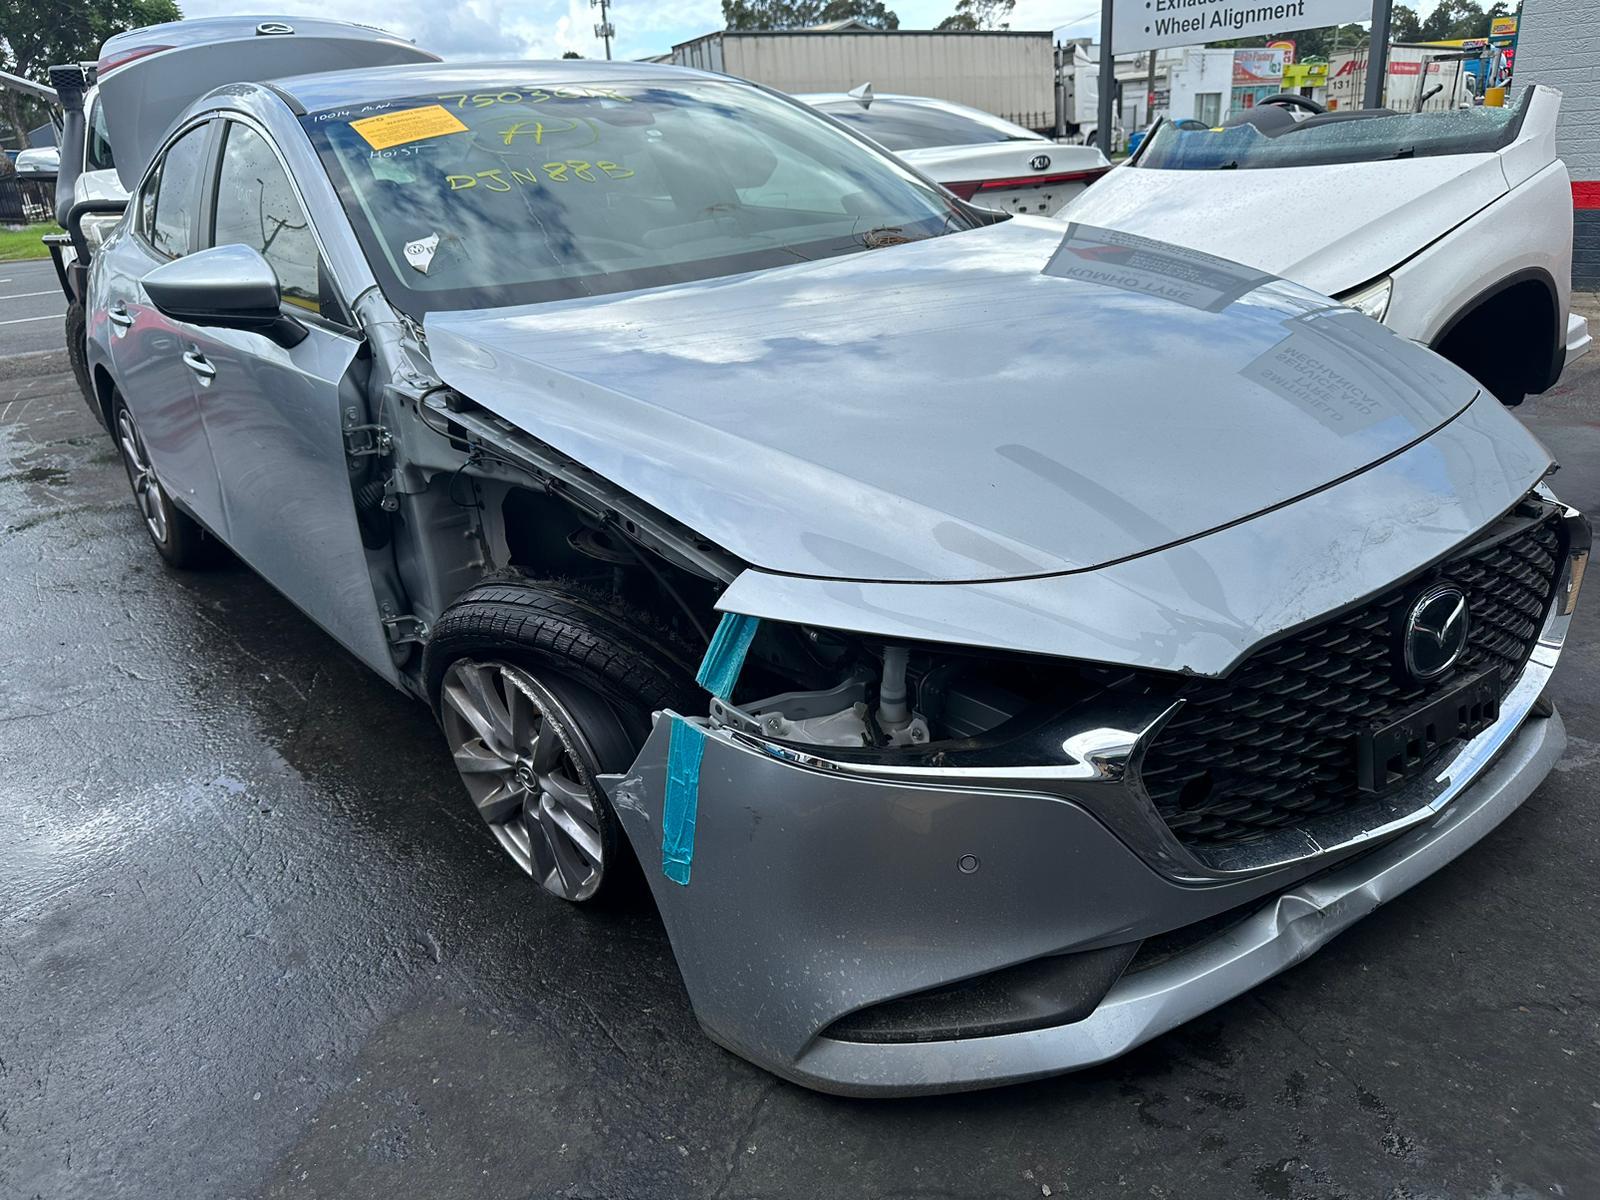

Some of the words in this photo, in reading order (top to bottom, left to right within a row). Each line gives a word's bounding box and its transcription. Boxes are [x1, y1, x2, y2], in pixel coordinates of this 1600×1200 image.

[1155, 12, 1205, 36] Wheel
[1210, 2, 1304, 29] Alignment
[1033, 156, 1050, 169] KIA
